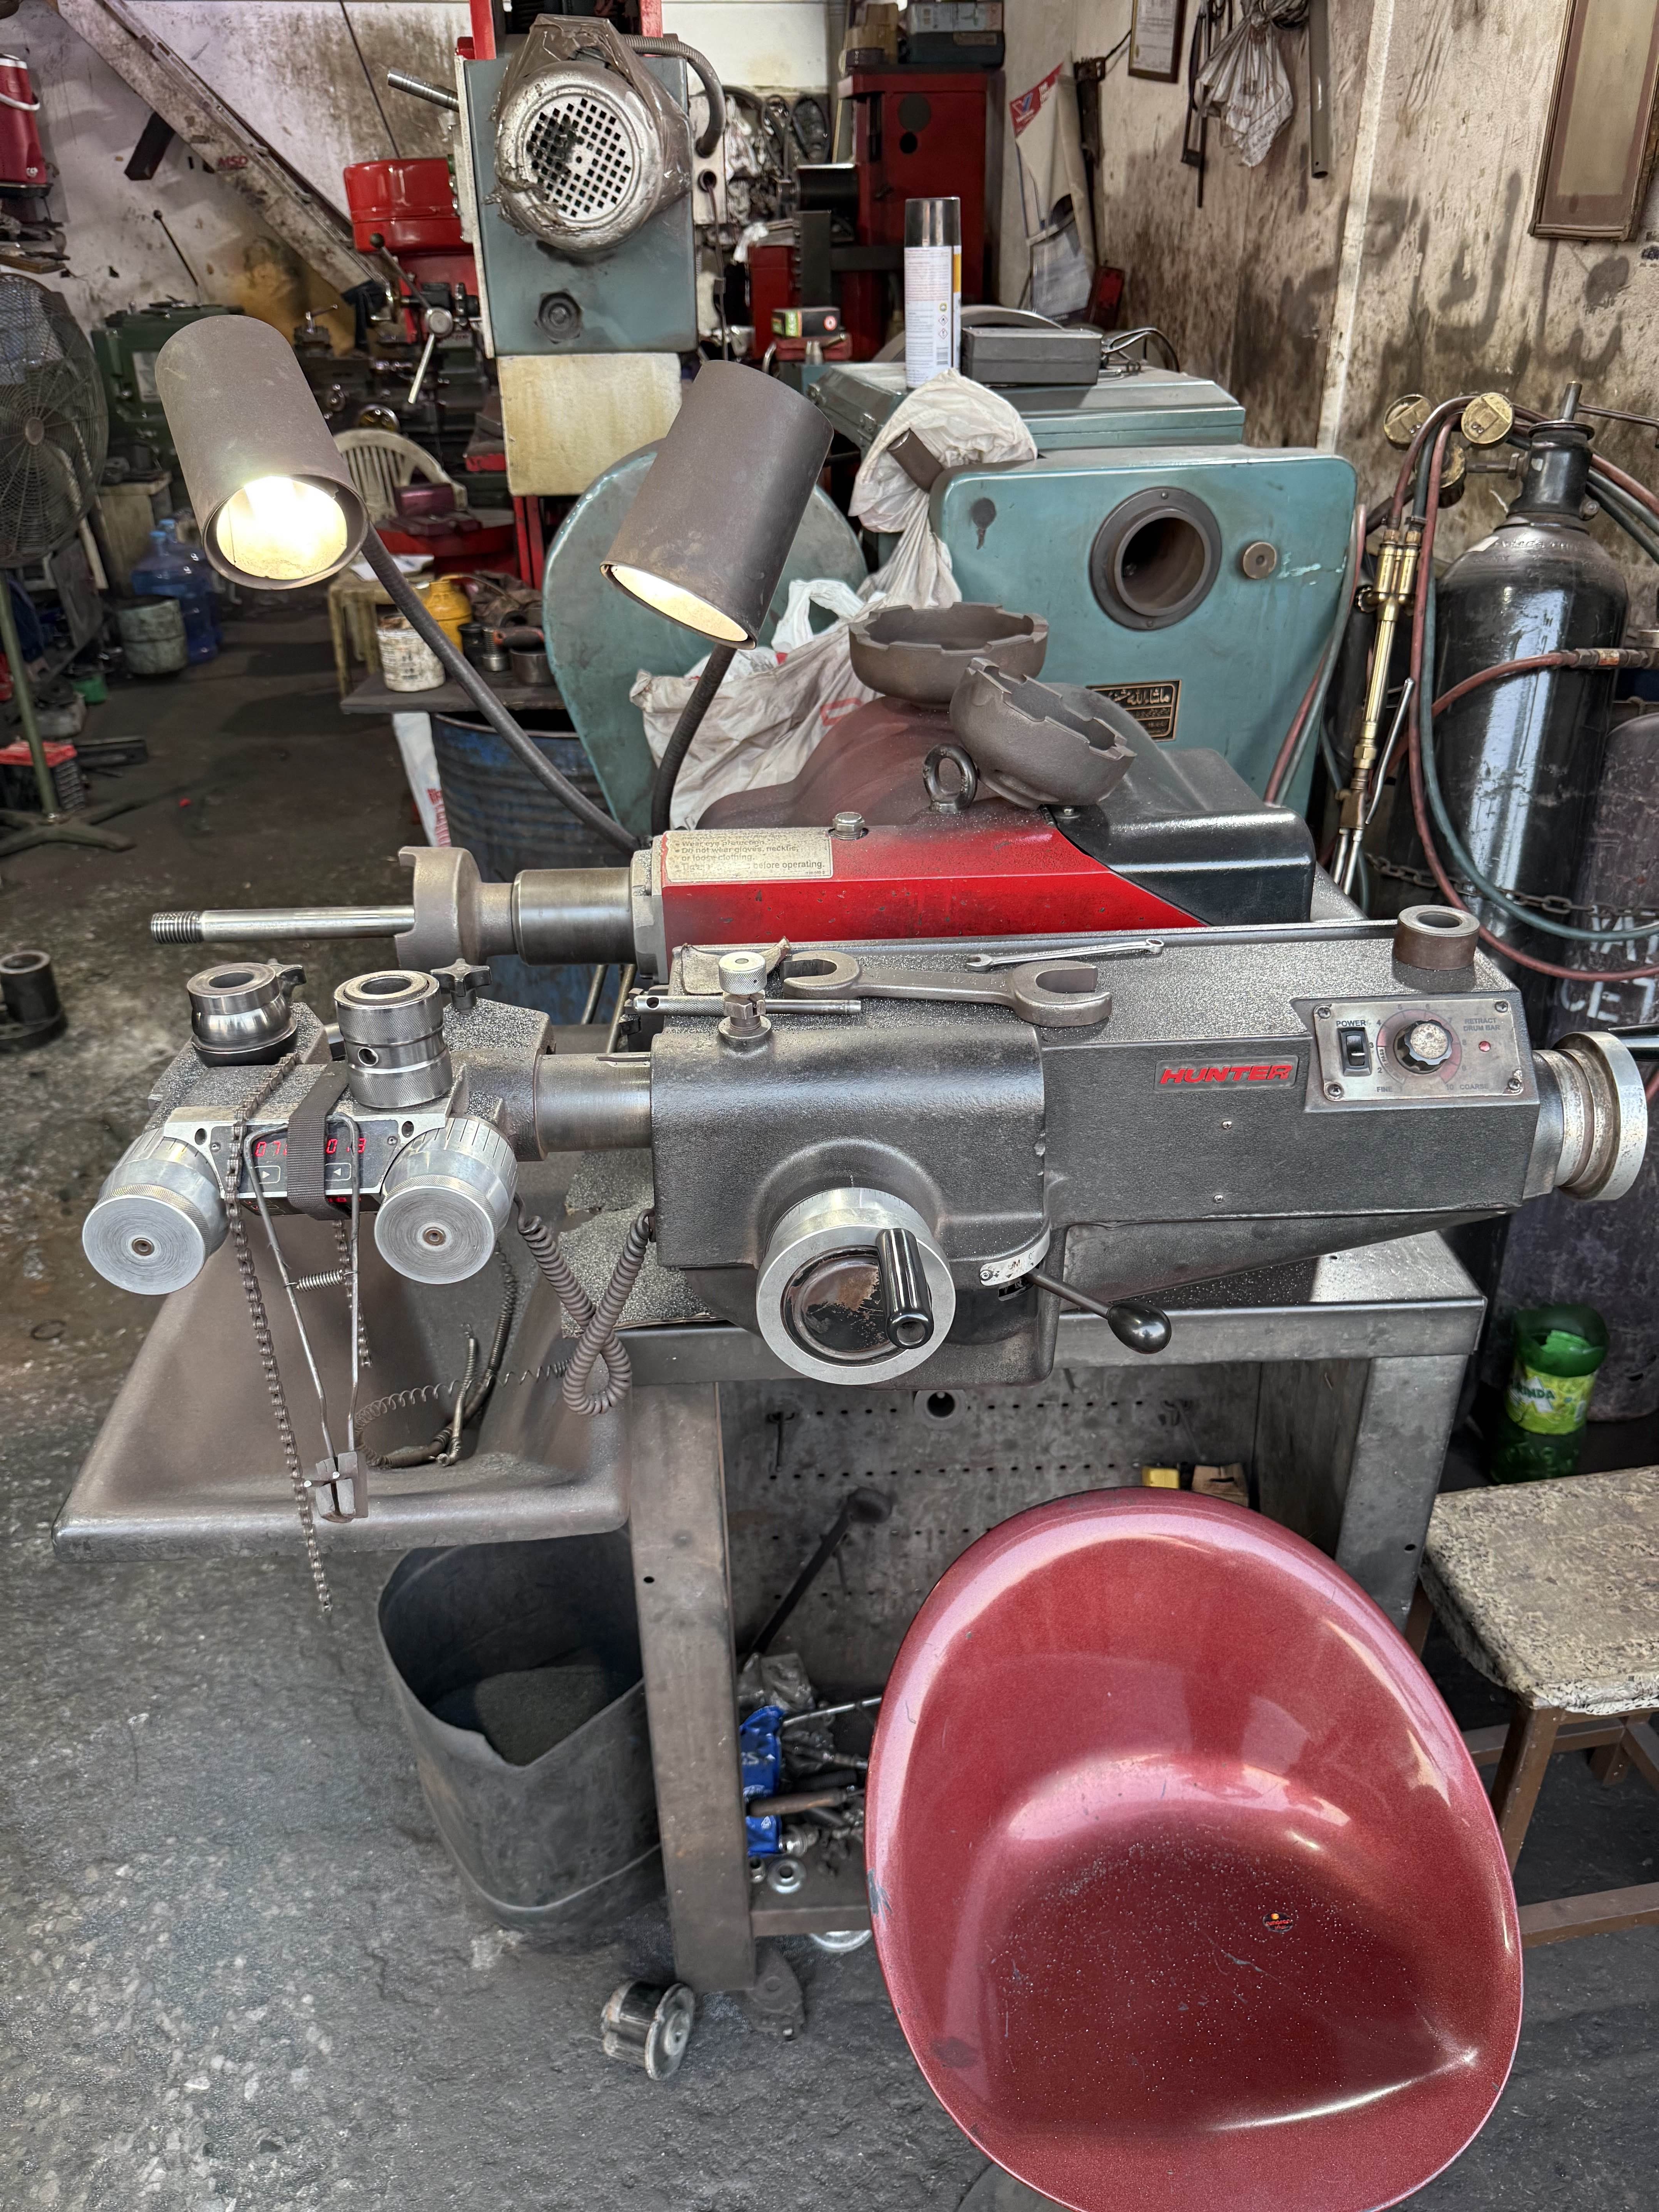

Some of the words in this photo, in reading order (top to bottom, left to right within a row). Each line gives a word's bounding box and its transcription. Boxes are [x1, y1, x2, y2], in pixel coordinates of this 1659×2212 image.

[782, 860, 825, 870] operating.
[1379, 1049, 1387, 1062] PASS
[1159, 1064, 1293, 1084] HUNTER
